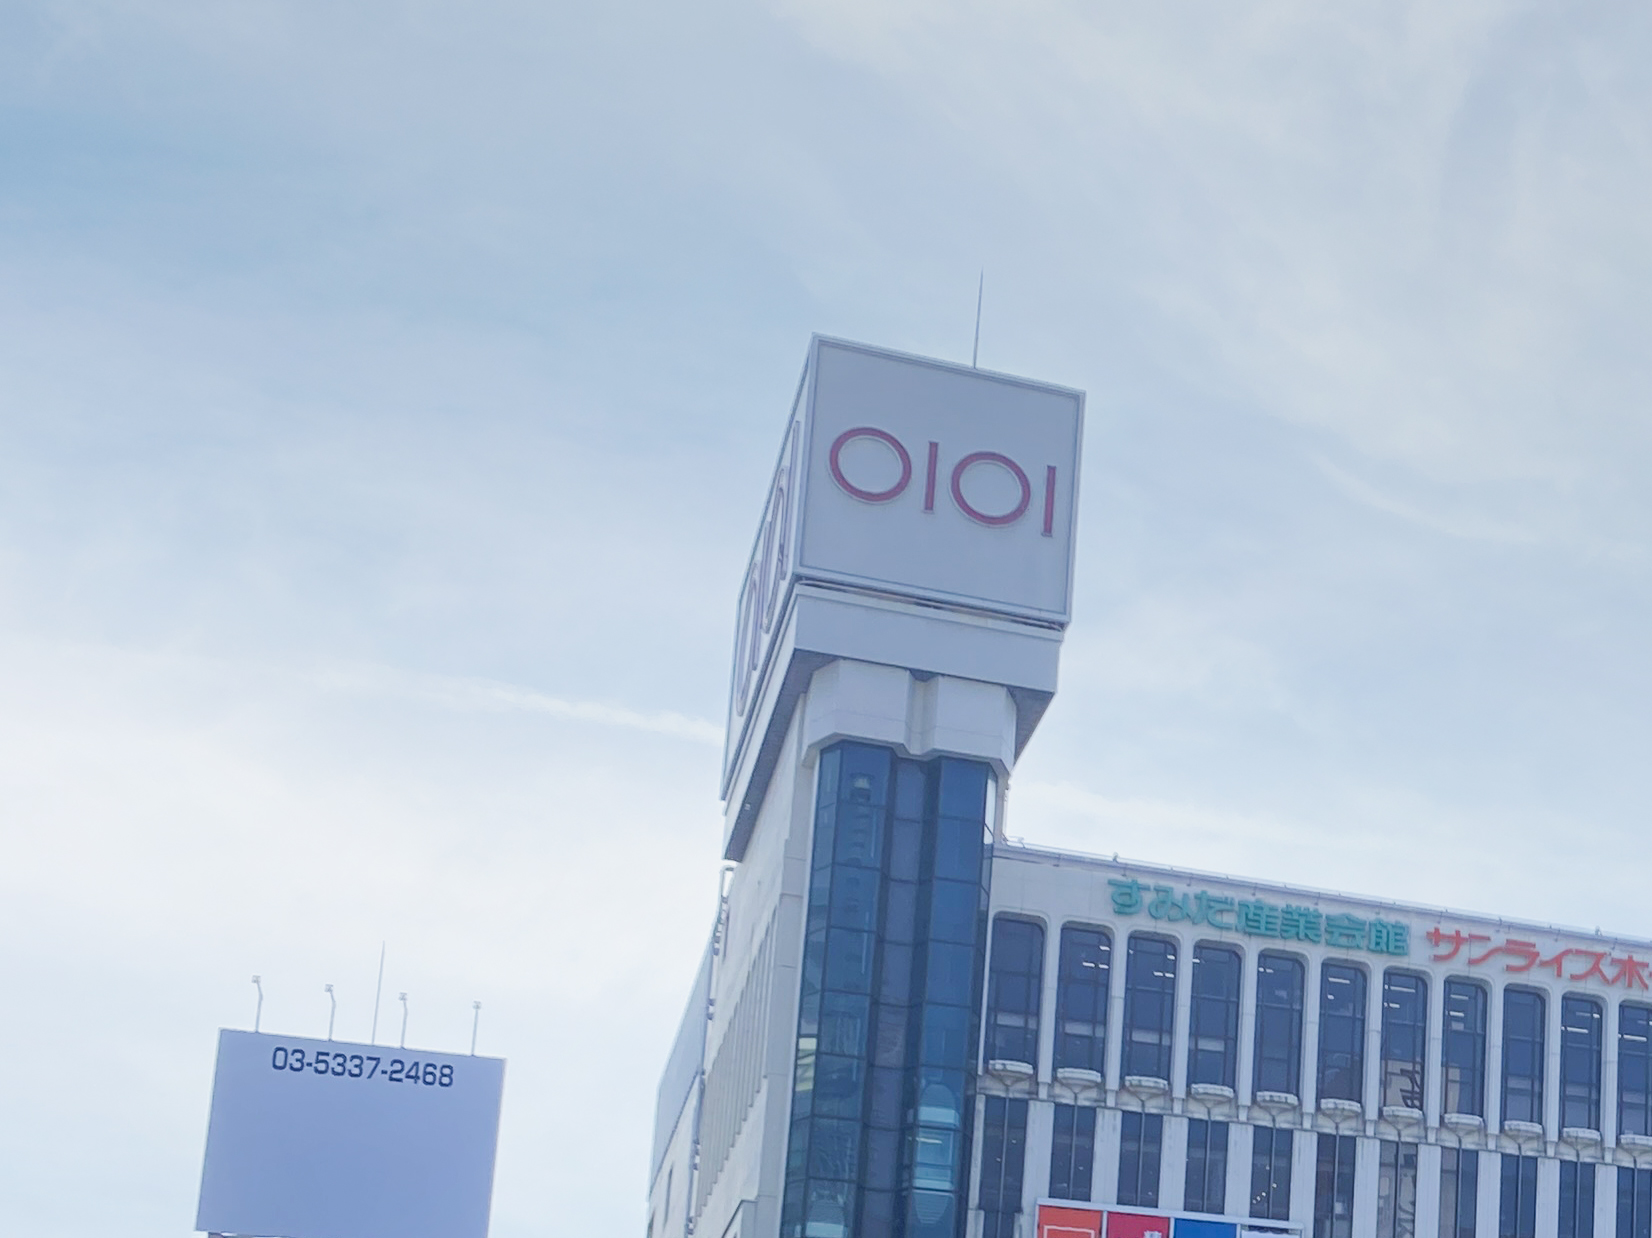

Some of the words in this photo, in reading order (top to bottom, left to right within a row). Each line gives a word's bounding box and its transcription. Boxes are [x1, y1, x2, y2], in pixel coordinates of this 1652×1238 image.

[1107, 878, 1409, 956] すみだ産業会館
[272, 1046, 454, 1088] 03-5337-2468
